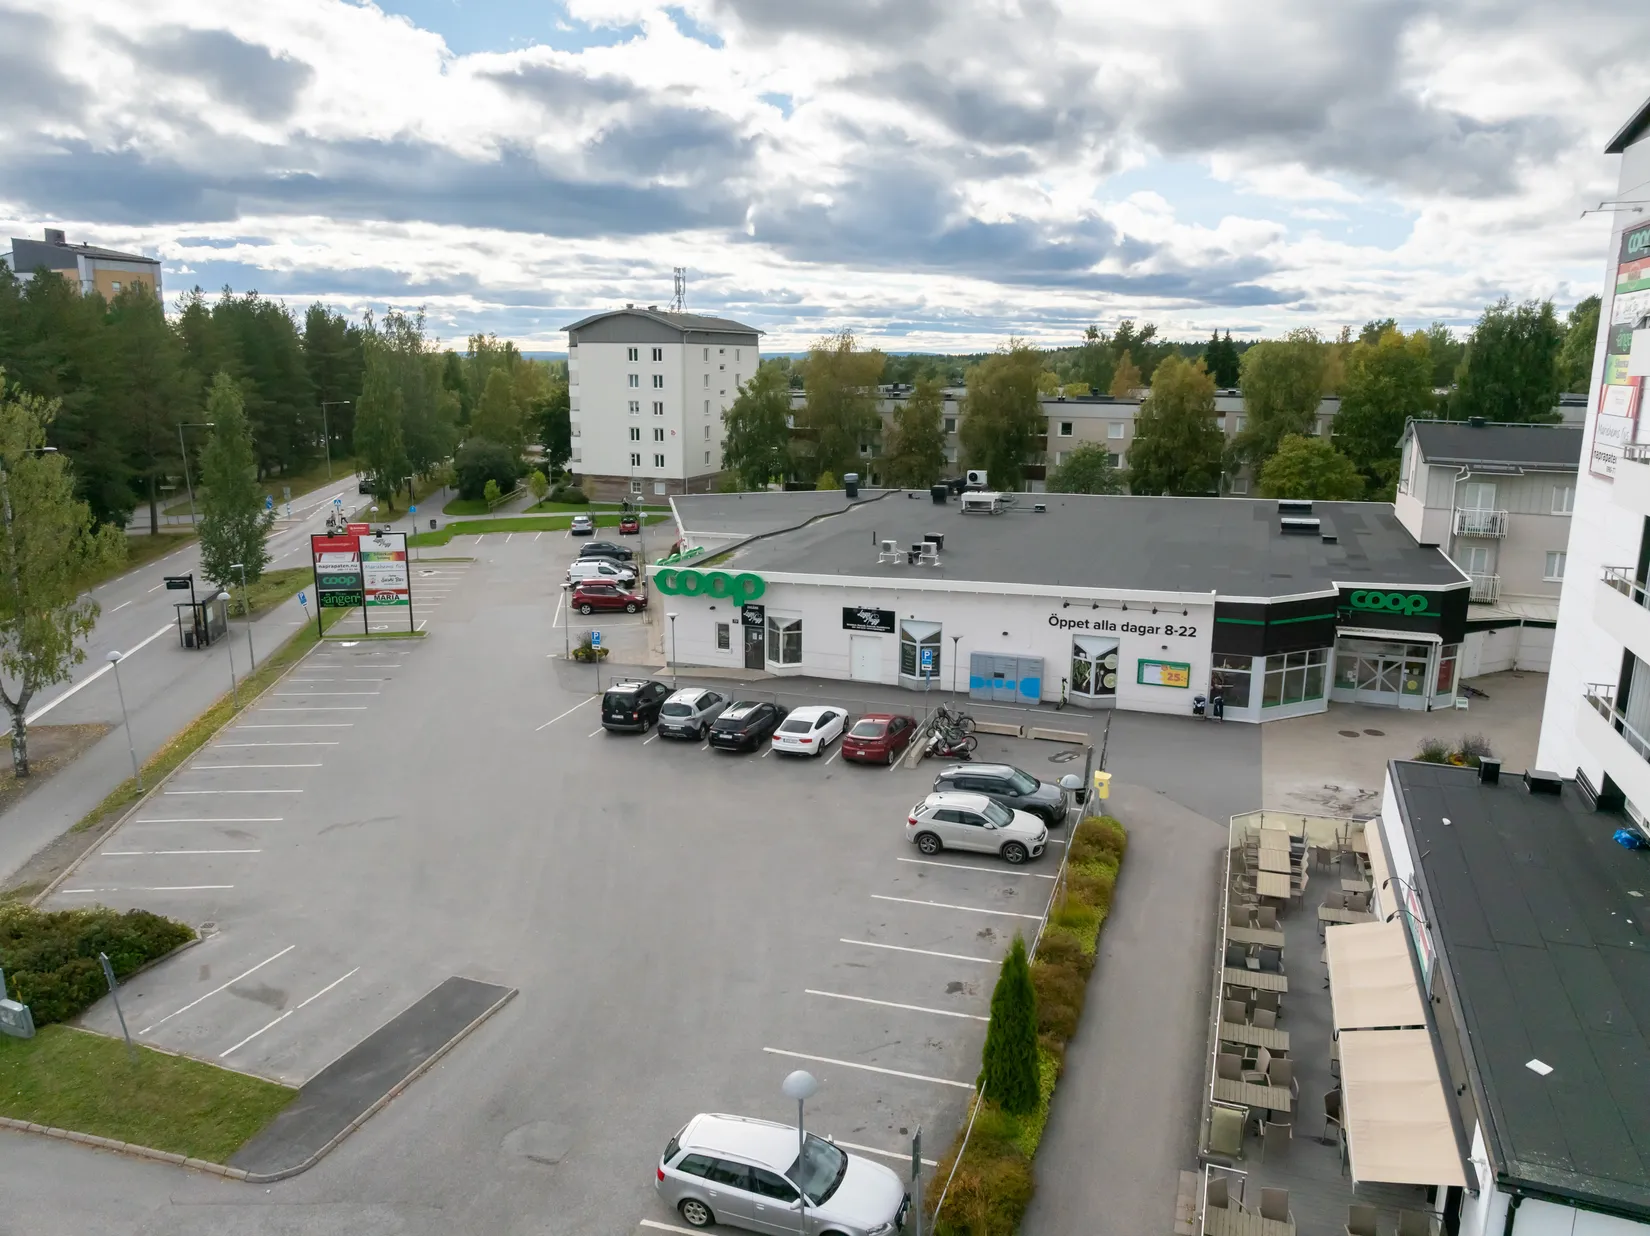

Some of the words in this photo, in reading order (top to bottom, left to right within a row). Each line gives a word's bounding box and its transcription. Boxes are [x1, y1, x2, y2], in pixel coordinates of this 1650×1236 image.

[322, 576, 357, 586] coop
[653, 568, 766, 607] coop
[1350, 590, 1429, 616] coop
[1048, 613, 1090, 630] Öppet
[1093, 619, 1117, 632] alla
[1121, 621, 1161, 636] dagar
[1164, 624, 1197, 638] 8-22
